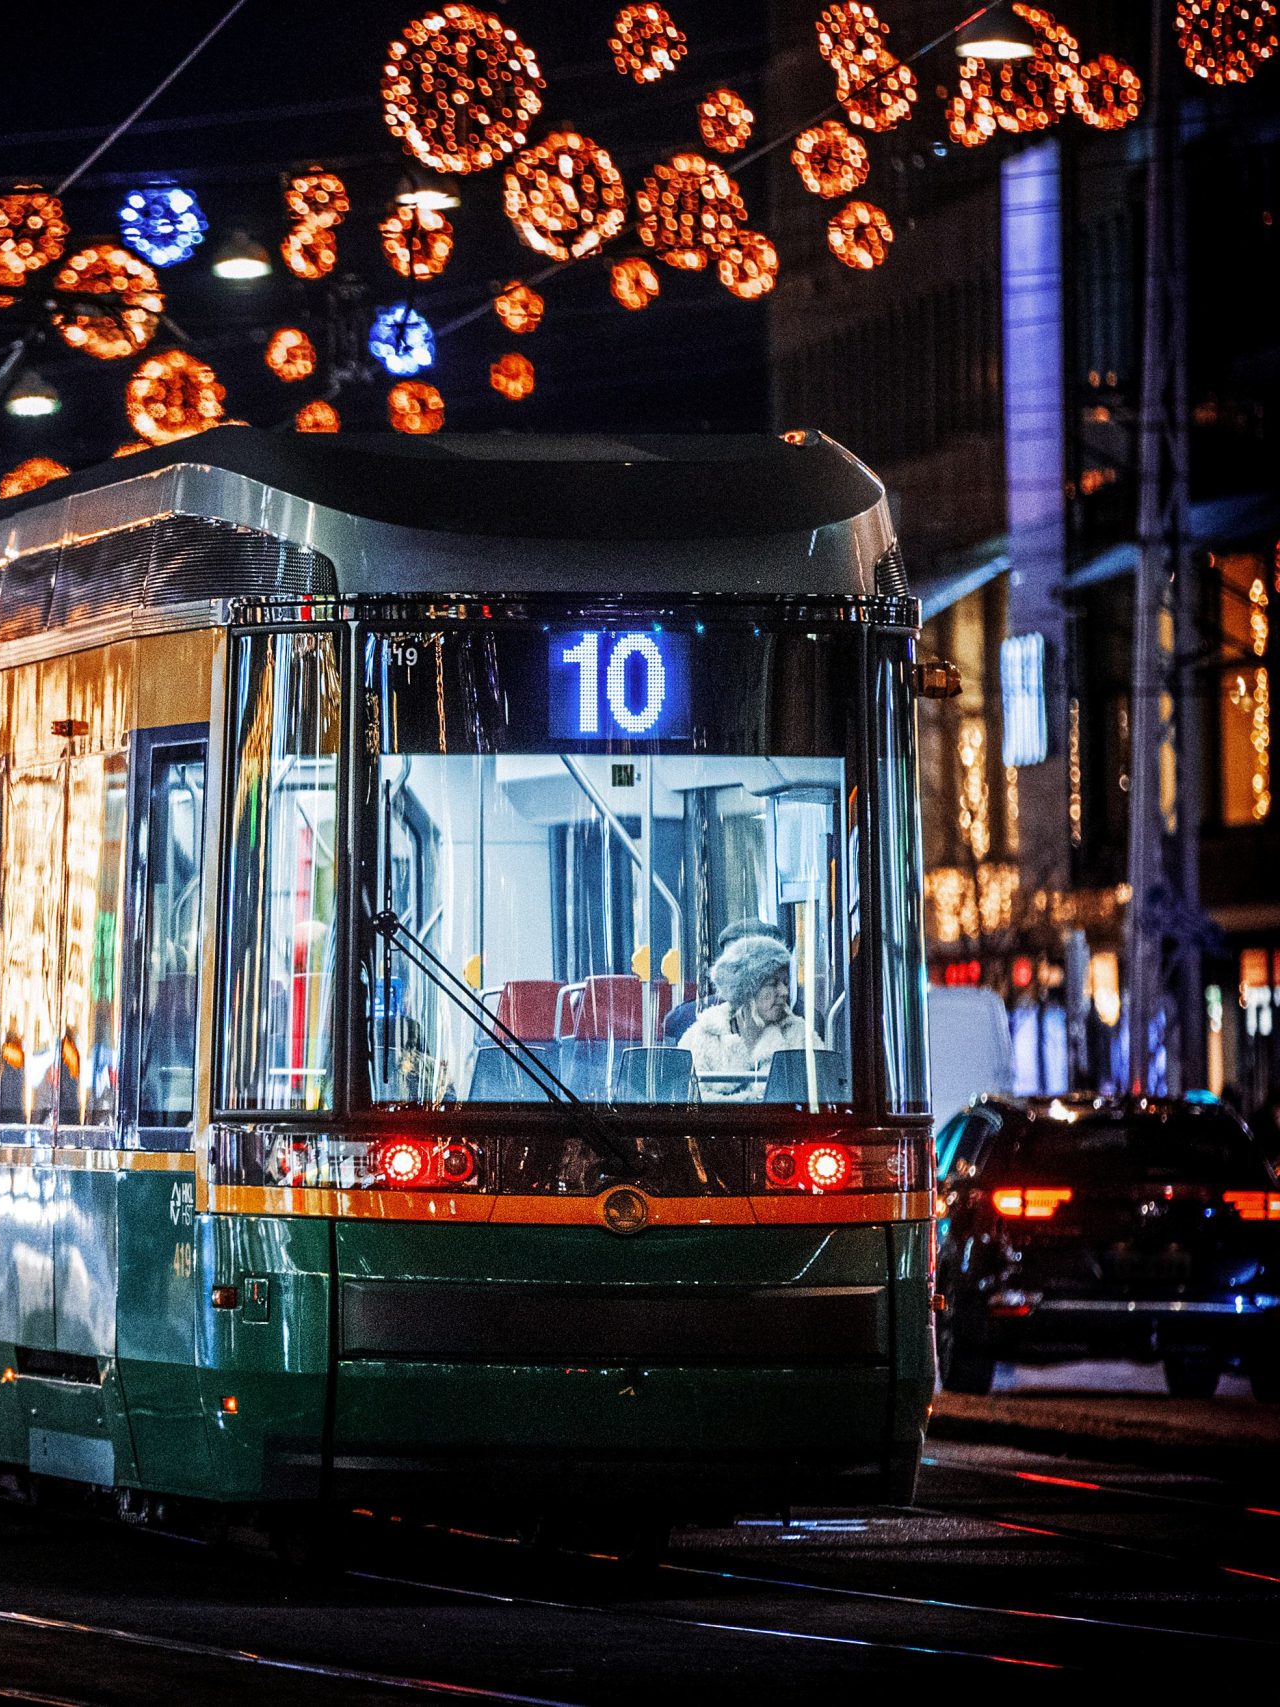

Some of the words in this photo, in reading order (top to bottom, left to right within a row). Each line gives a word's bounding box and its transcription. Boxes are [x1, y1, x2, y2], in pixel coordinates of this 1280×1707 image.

[563, 633, 666, 733] 10
[181, 1182, 194, 1204] HKL
[181, 1204, 194, 1226] HST
[173, 1242, 192, 1277] 419
